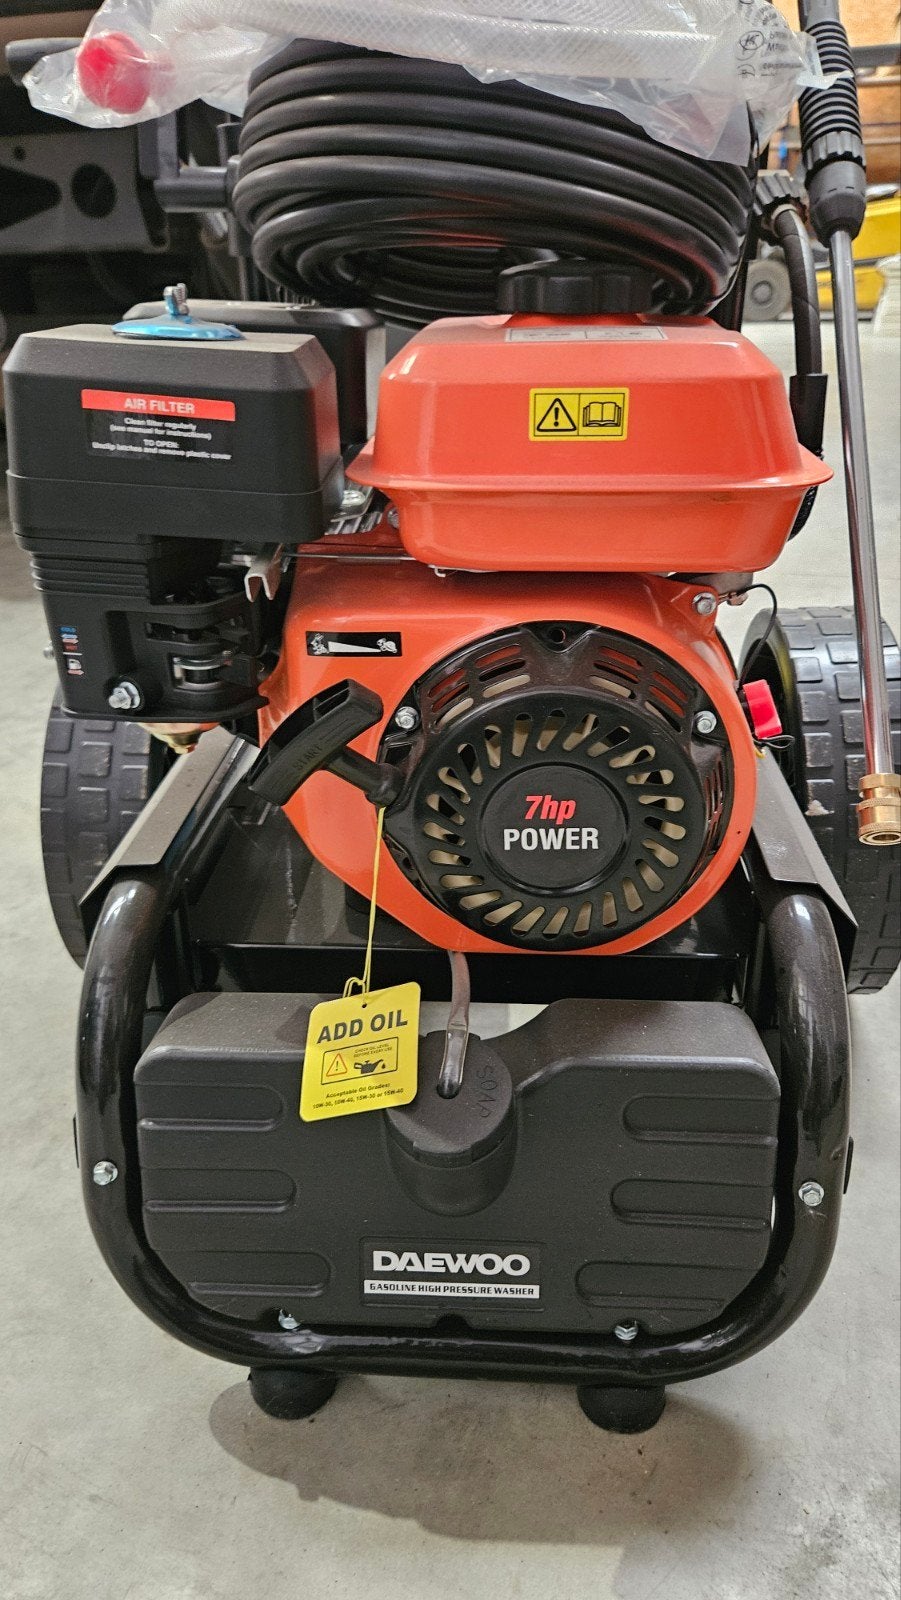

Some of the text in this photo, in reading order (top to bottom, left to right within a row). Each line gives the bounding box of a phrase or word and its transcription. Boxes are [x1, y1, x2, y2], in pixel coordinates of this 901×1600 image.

[124, 398, 195, 414] AIR FILTER
[124, 417, 197, 432] Clean filter regularly
[126, 426, 154, 434] manual
[143, 439, 155, 447] TO
[143, 446, 158, 454] and
[524, 794, 577, 825] 7hp
[503, 827, 599, 851] POWER
[316, 1009, 408, 1044] ADD OIL
[326, 1088, 357, 1099] Acceptable
[373, 1250, 531, 1276] DAEWOO
[369, 1283, 534, 1295] GASOLINE HIGH PRESSURE WASHER
